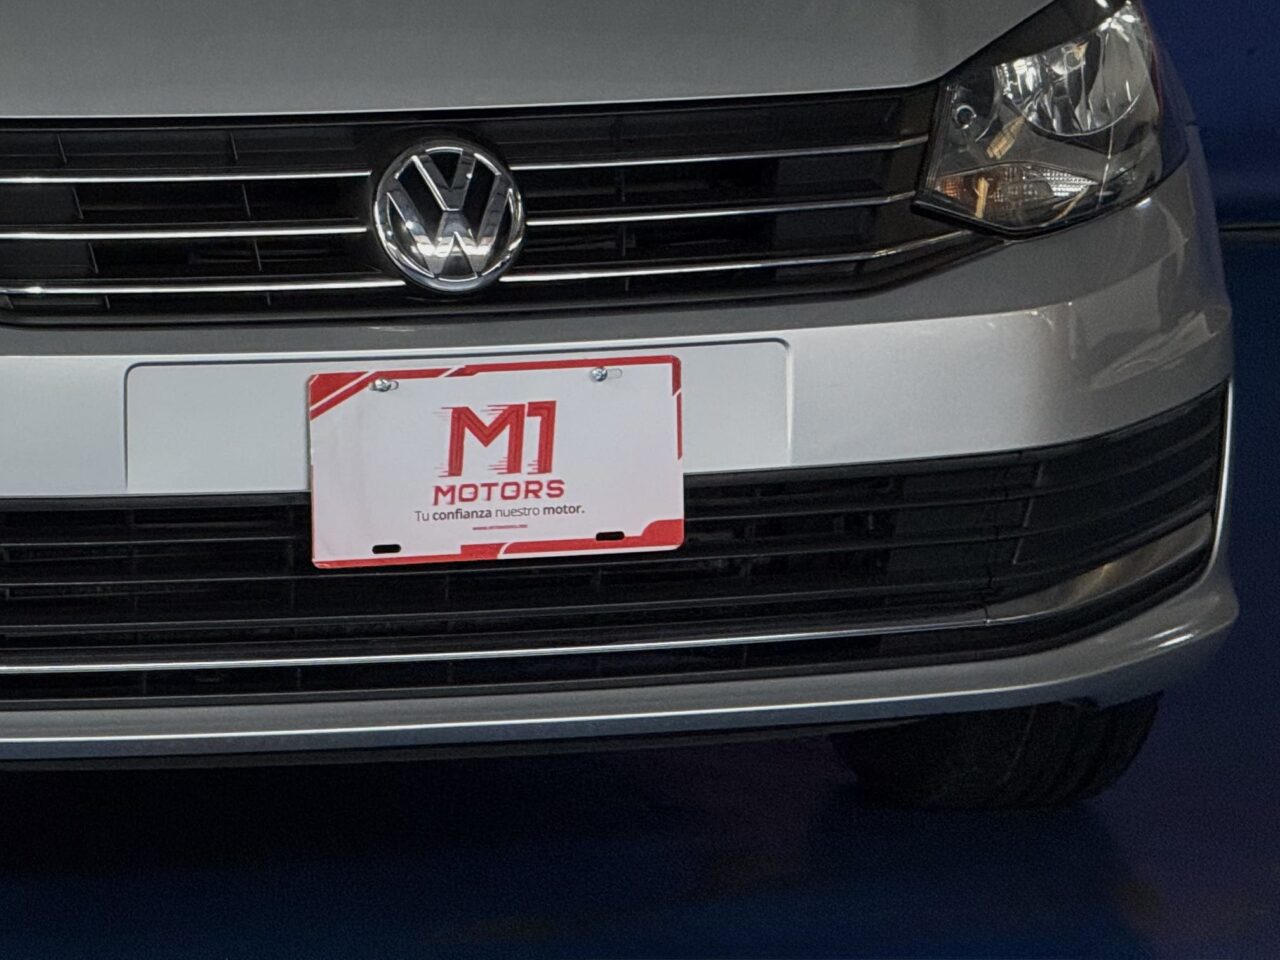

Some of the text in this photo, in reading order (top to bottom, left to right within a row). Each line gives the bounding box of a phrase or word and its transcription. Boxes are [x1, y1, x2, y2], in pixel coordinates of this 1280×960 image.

[440, 401, 557, 478] M1
[432, 479, 565, 507] MOTORS
[414, 504, 585, 522] Tu confianza nuestro motor.
